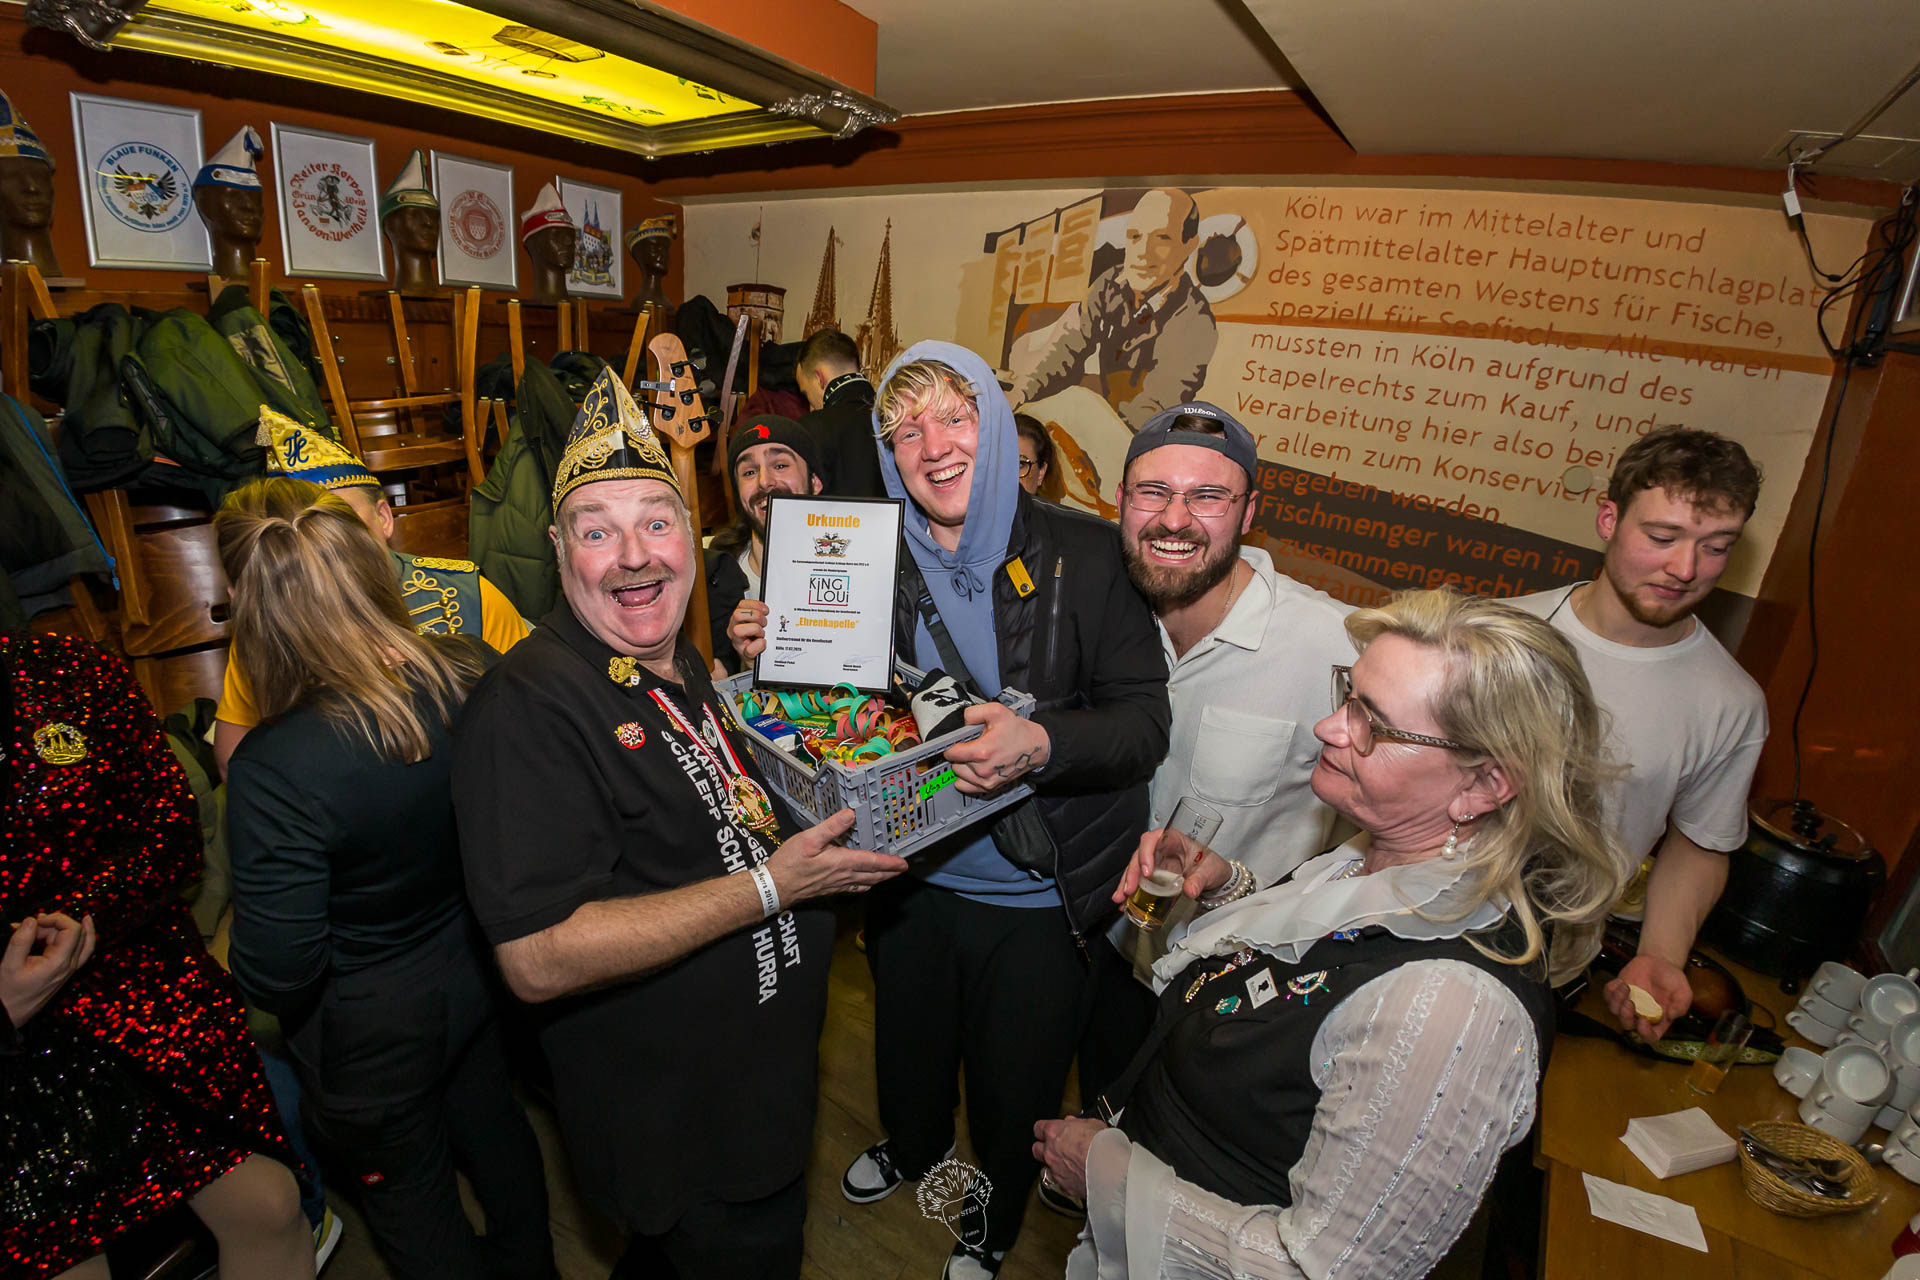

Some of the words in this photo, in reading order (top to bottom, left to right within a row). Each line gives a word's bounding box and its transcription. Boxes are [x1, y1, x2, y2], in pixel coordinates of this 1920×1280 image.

[106, 146, 136, 166] BLAUE
[138, 146, 179, 173] FUNKEN
[290, 163, 328, 188] Reiter
[1275, 229, 1498, 268] Spätmittelalter
[1285, 195, 1343, 221] Köln
[1356, 206, 1408, 225] war
[1418, 204, 1453, 228] im
[1463, 208, 1635, 245] Mittelalter
[1645, 228, 1706, 253] und
[1268, 262, 1312, 287] des
[1322, 271, 1461, 298] gesamten
[1476, 279, 1600, 317] Westens
[1614, 293, 1661, 323] für
[1671, 302, 1783, 349] Fische,
[1251, 333, 1362, 360] mussten
[1374, 340, 1399, 363] in
[1411, 343, 1475, 373] Köln
[1486, 357, 1629, 395] aufgrund
[1640, 375, 1693, 405] des
[1267, 301, 1373, 325] speziell
[1384, 305, 1428, 327] für
[1439, 311, 1591, 351] Seefische.
[1604, 332, 1663, 363] Alle
[1684, 347, 1782, 380] Waren
[1183, 407, 1217, 417] Wilson
[1237, 392, 1412, 442] Verarbeitung
[1422, 416, 1482, 447] hier
[1493, 430, 1553, 460] also
[1566, 439, 1617, 470] bei
[1242, 360, 1415, 402] Stapelrechts
[1425, 387, 1487, 411] zum
[1500, 392, 1578, 432] Kauf,
[1595, 413, 1657, 437] und
[1257, 461, 1378, 501] igegeben
[1391, 489, 1509, 526] werden.
[1276, 432, 1350, 462] allem
[1362, 450, 1421, 474] zum
[1433, 455, 1608, 506] Konservire
[807, 513, 860, 528] Urkunde
[1259, 495, 1438, 549] Fischmenger
[1448, 534, 1541, 570] waren
[1552, 551, 1580, 578] in
[1278, 538, 1537, 598] zusammengeschl
[661, 730, 722, 820] SCHLEPP
[752, 927, 777, 1005] HURRA
[777, 909, 801, 968] CHAFT
